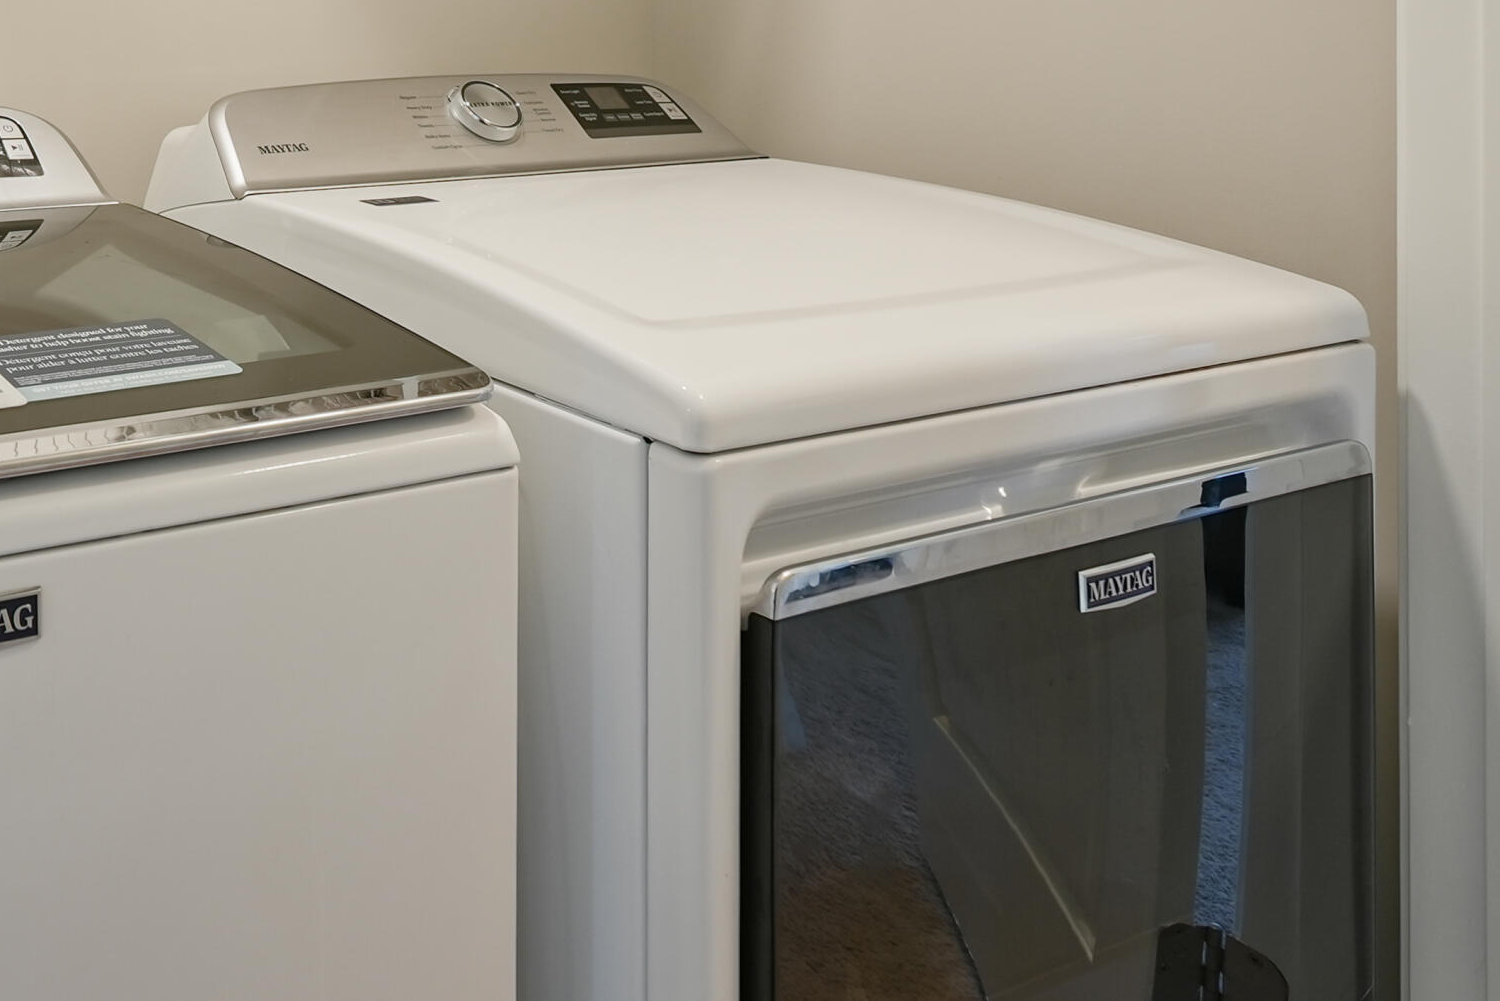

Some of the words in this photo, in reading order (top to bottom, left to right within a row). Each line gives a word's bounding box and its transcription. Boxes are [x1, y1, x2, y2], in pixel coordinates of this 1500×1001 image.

[257, 142, 309, 155] MAYTAG
[44, 339, 68, 349] help
[69, 335, 101, 344] boost
[57, 329, 103, 340] designed
[95, 347, 120, 355] pour
[150, 338, 192, 347] laveuse
[6, 364, 35, 374] pour
[37, 359, 66, 369] aider
[77, 354, 110, 365] lutter
[110, 350, 146, 359] contre
[163, 344, 199, 353] taches
[1088, 565, 1153, 602] MAYTAG
